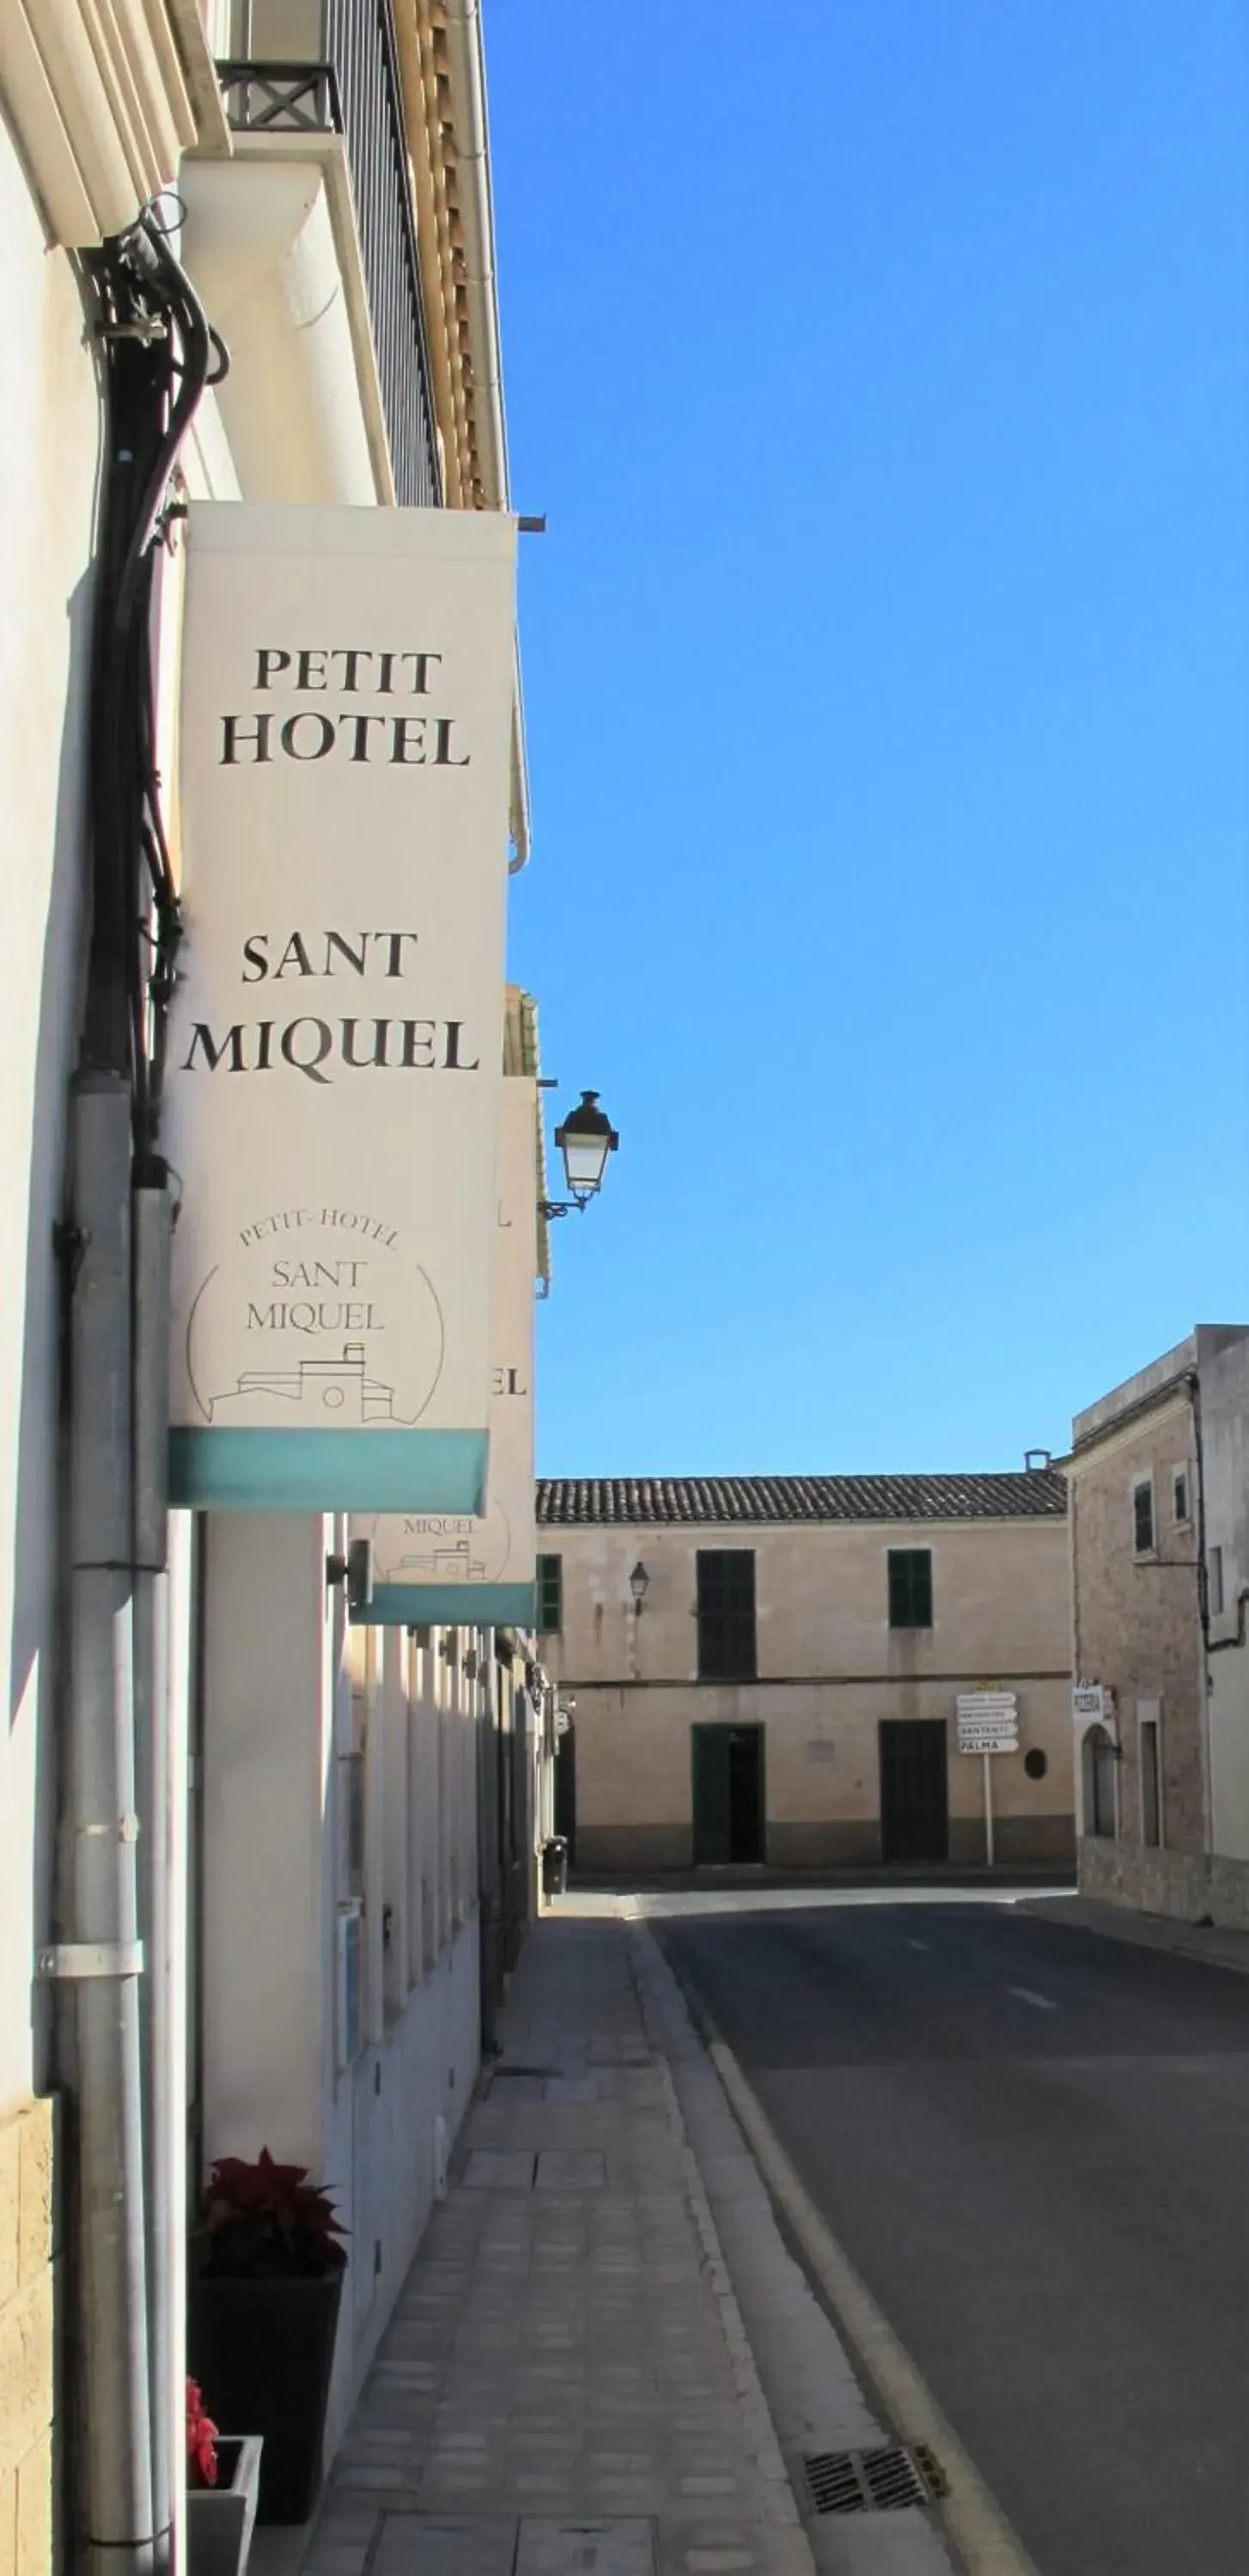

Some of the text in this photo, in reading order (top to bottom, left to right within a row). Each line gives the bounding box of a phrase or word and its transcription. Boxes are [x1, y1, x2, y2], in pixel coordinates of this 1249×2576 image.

[253, 648, 442, 695] PETIT
[218, 712, 472, 767] HOTEL
[241, 931, 418, 983] SANT
[179, 1016, 480, 1084] MIQUEL
[271, 1260, 370, 1289] SANT
[247, 1302, 385, 1335] MIQUEL
[403, 1518, 480, 1537] MIQUEL
[961, 1741, 999, 1750] PALMA
